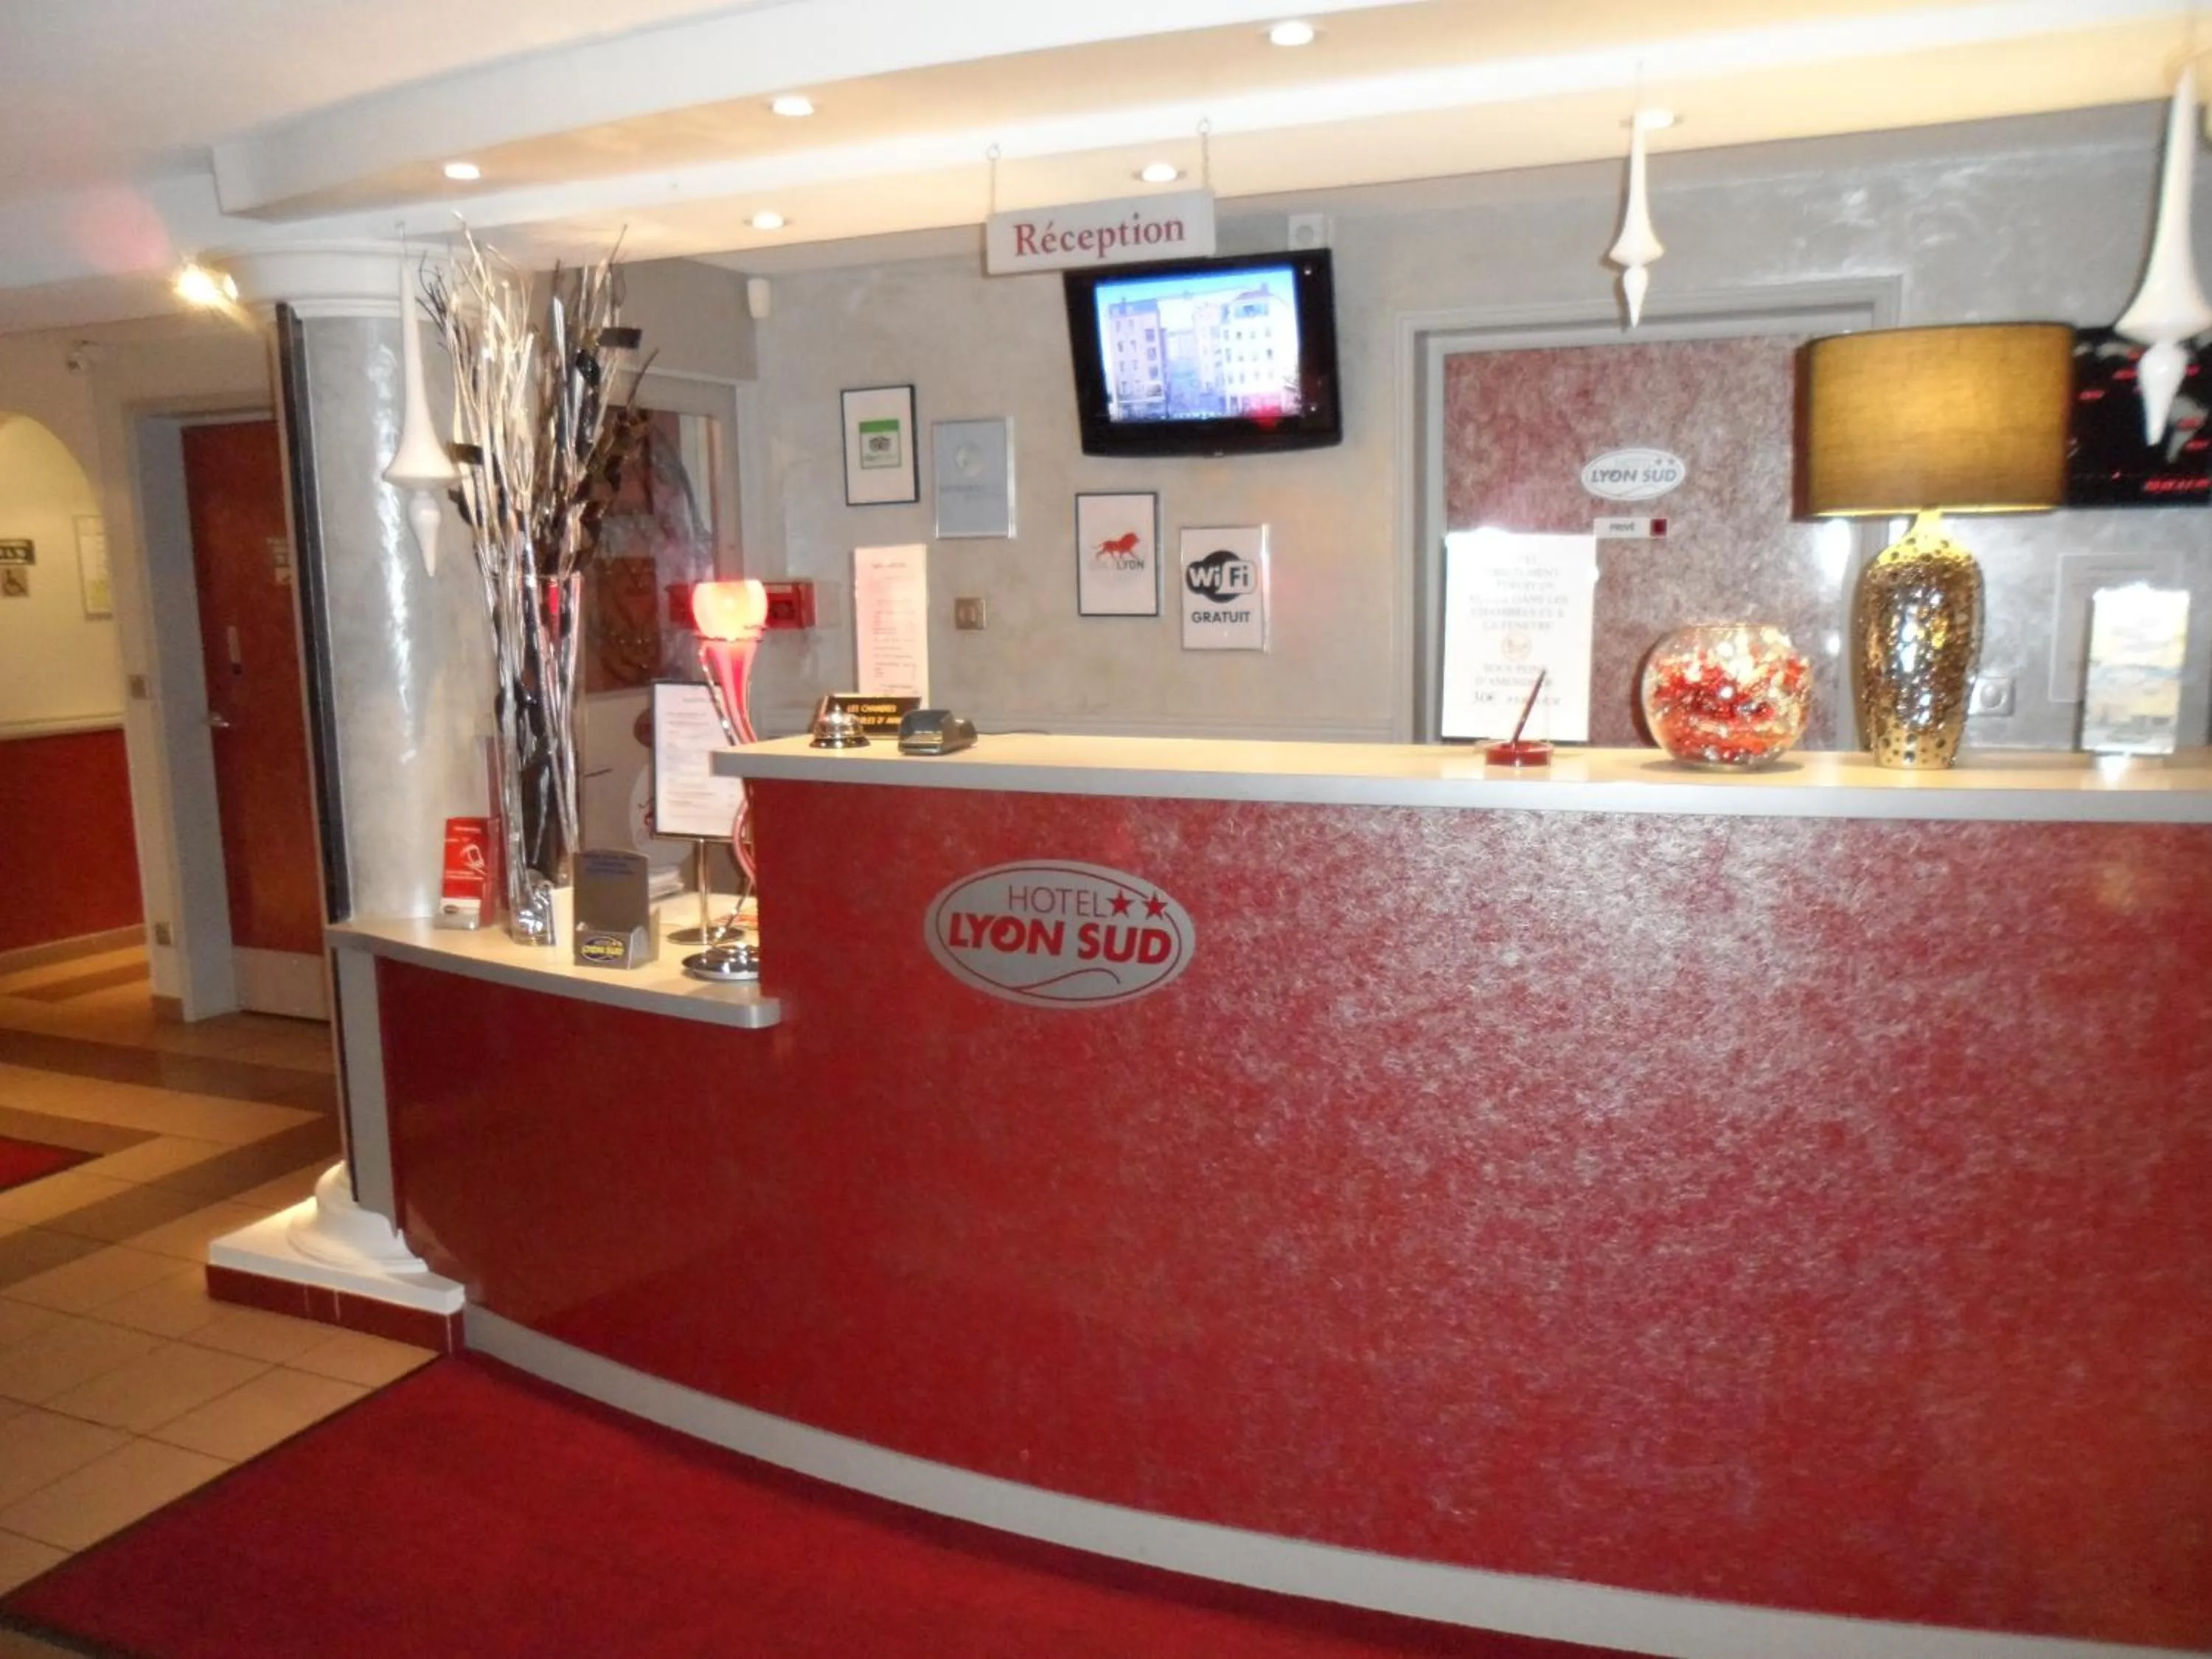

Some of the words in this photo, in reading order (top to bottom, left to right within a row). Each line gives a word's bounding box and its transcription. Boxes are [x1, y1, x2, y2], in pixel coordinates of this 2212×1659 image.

[1014, 212, 1186, 258] Réception
[1590, 469, 1638, 484] LYON
[1641, 468, 1678, 484] SUD
[1116, 560, 1144, 571] LYON
[1191, 611, 1251, 623] GRATUIT
[1007, 885, 1108, 919] HOTEL
[948, 911, 1065, 956] LYON
[1076, 922, 1173, 965] SUD
